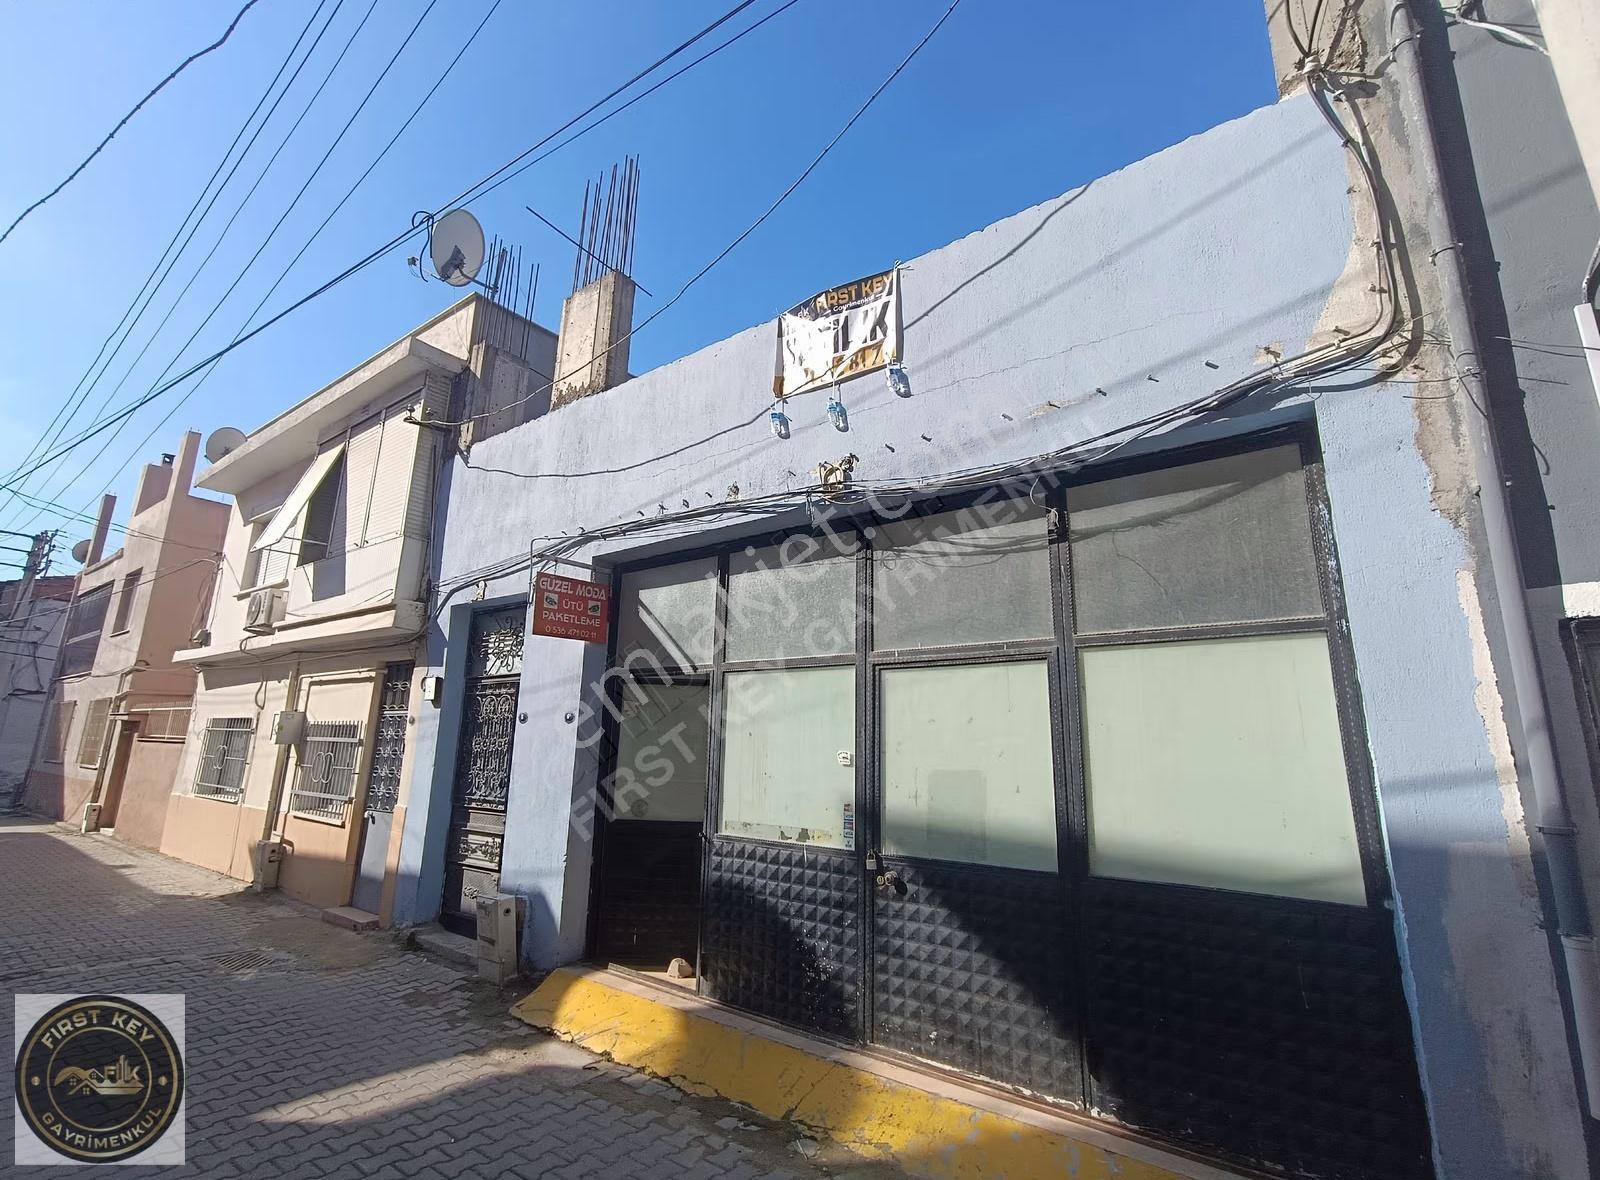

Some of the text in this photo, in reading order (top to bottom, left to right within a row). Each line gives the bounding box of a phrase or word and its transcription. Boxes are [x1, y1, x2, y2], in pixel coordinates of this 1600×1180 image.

[861, 272, 893, 297] KEY
[540, 577, 606, 600] GÜZEL MODA
[562, 599, 583, 611] ÜTÜ
[543, 611, 600, 627] PAKETLEME
